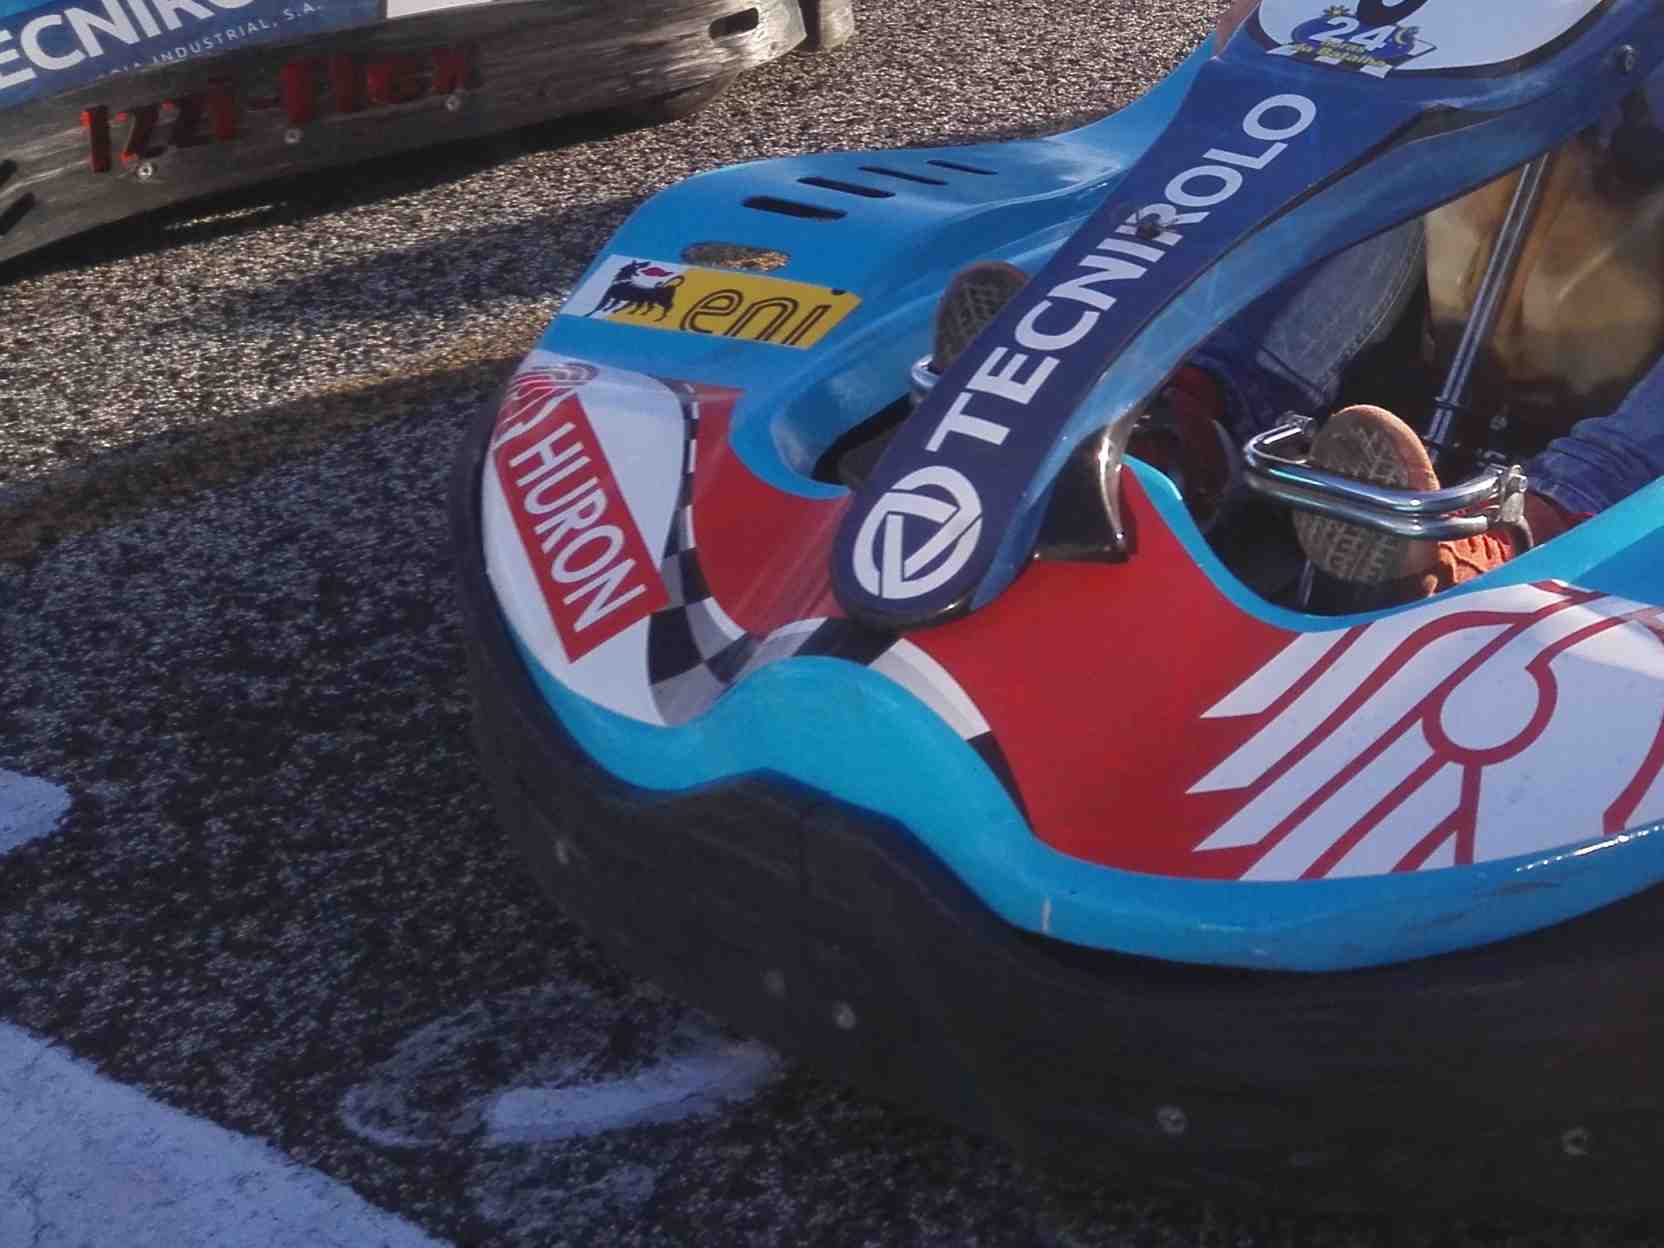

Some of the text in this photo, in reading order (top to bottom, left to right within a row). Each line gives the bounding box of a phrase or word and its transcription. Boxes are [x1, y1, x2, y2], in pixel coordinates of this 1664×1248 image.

[1308, 16, 1397, 52] 24
[678, 283, 848, 347] eni
[927, 93, 1319, 454] TECNIROLO
[510, 429, 647, 632] HURON
